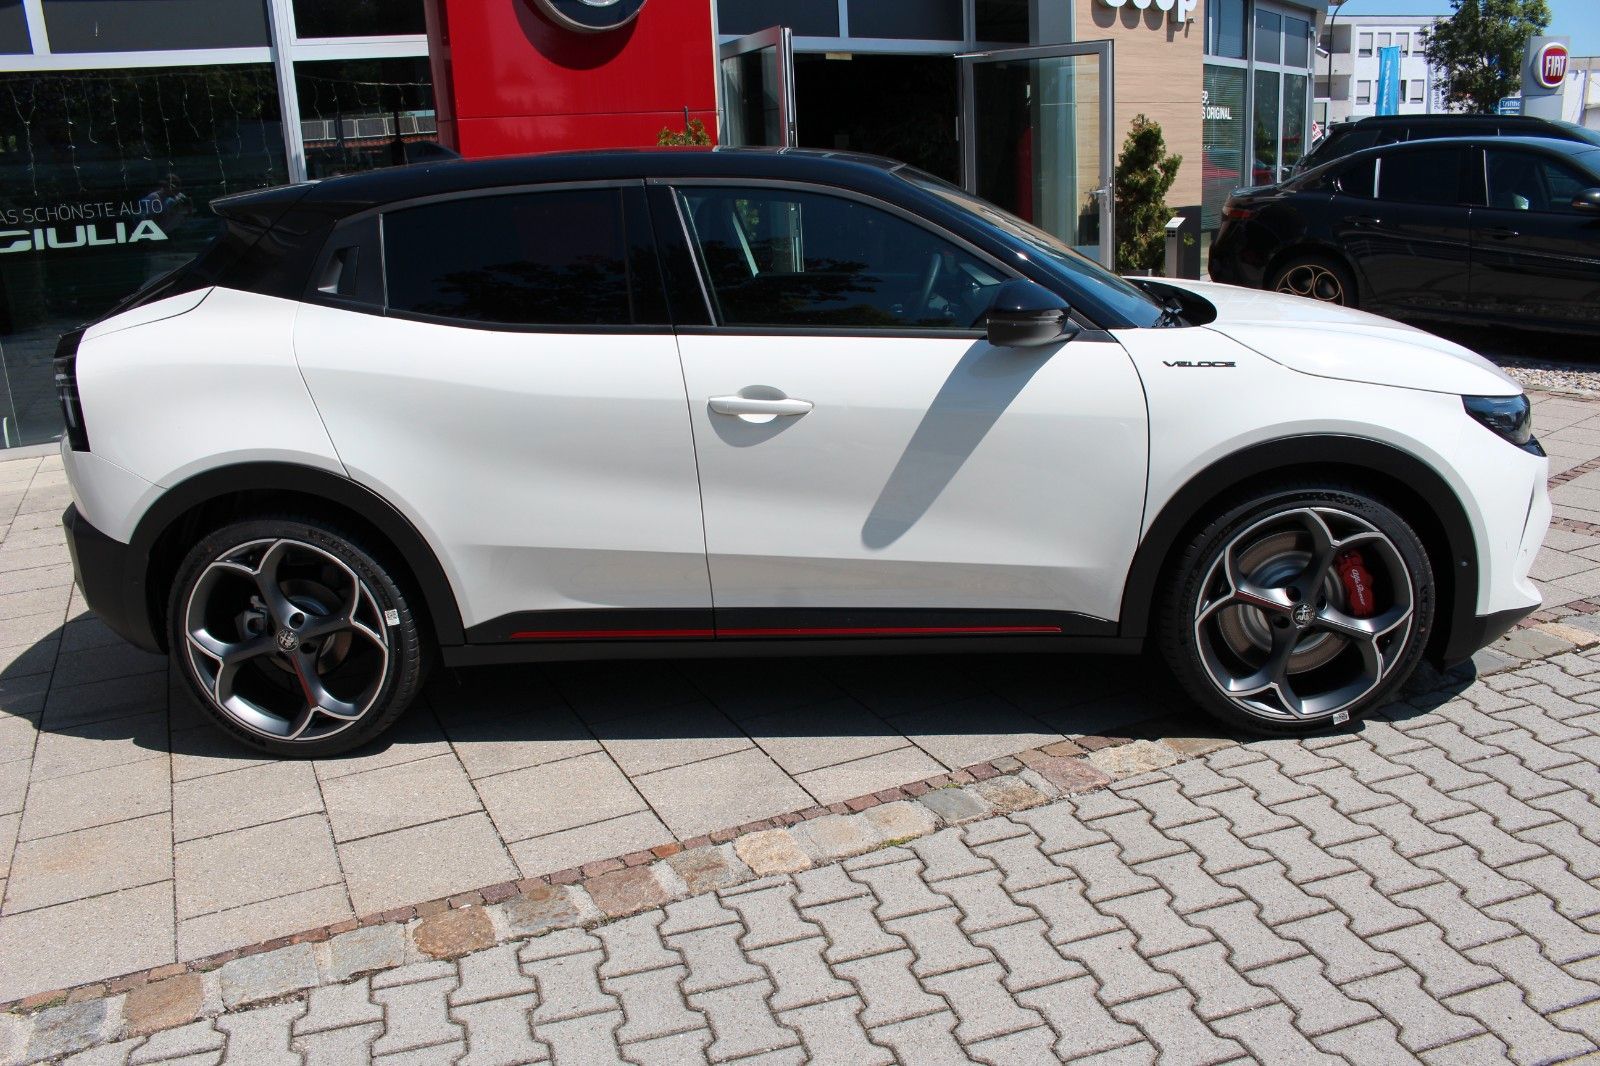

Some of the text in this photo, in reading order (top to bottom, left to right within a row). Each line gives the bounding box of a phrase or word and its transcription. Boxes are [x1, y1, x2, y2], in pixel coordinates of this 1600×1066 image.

[1545, 55, 1566, 77] FIAT
[23, 202, 117, 224] SCHÖNSTE
[120, 199, 163, 216] AUTO
[0, 219, 169, 253] GIULIA
[1162, 360, 1237, 368] VELOCE
